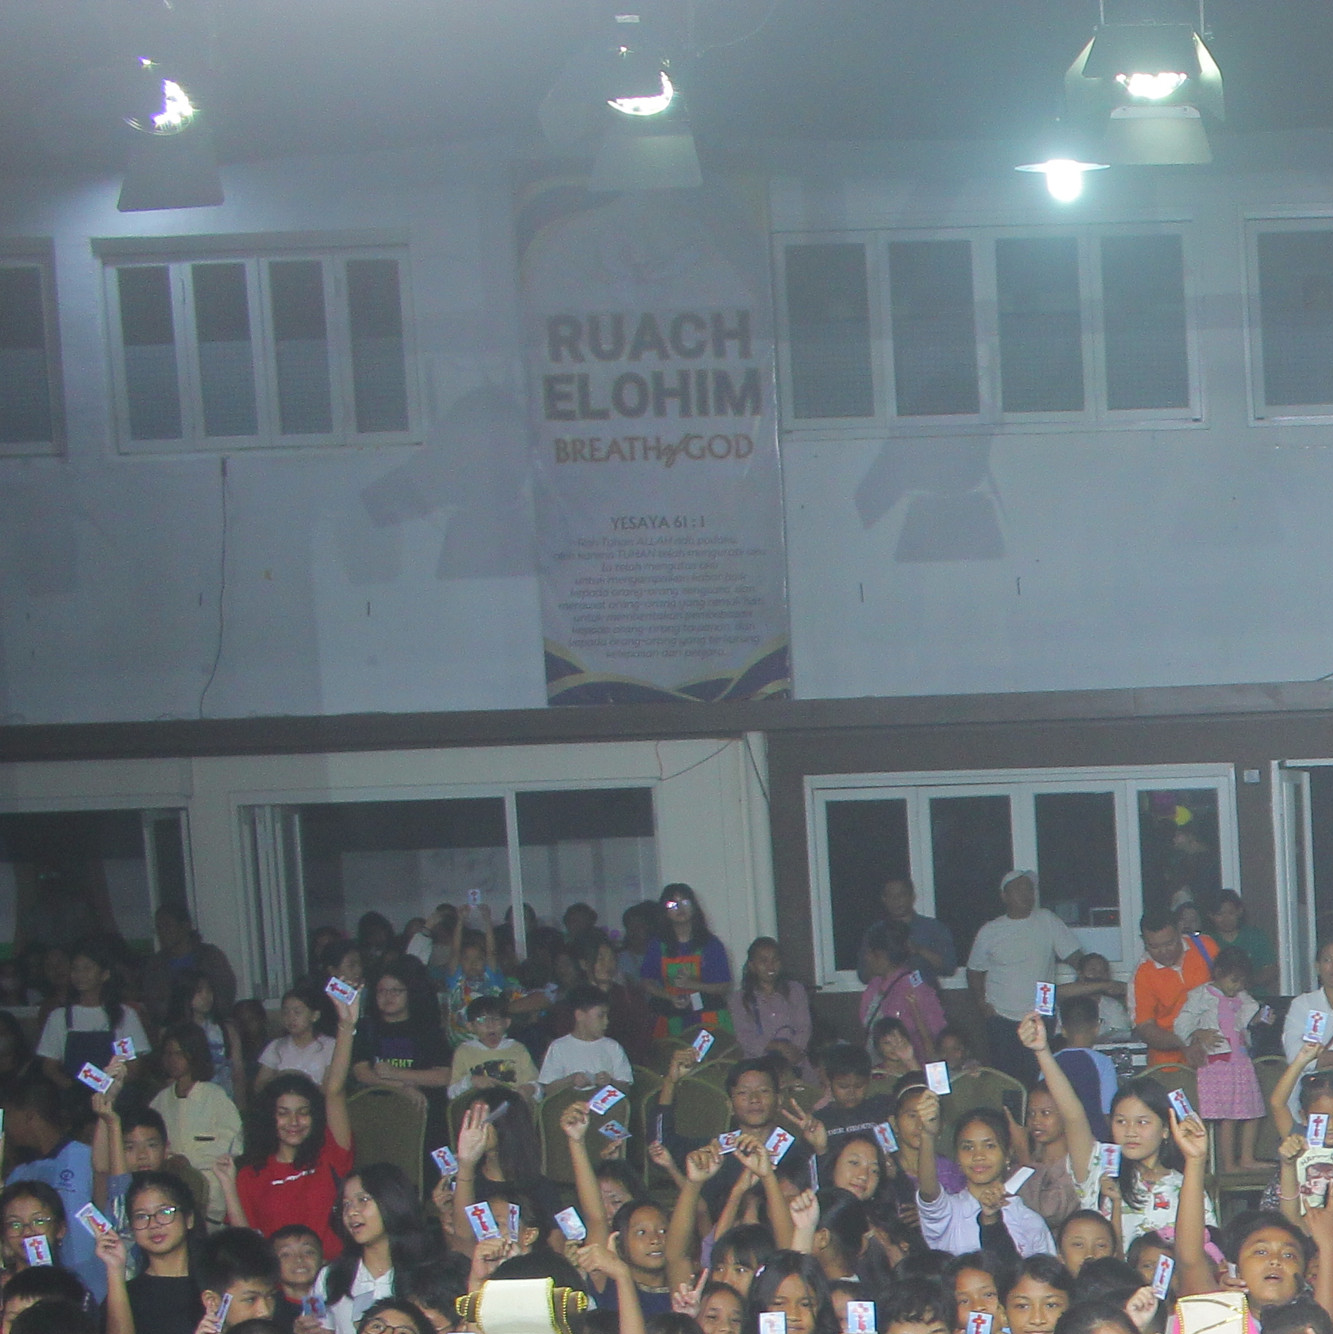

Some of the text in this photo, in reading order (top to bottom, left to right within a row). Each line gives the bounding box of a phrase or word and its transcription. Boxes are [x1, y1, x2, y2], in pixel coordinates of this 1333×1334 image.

[545, 307, 753, 364] RUACH
[543, 366, 763, 421] ELOHIM
[554, 437, 661, 464] BREATH
[685, 434, 755, 460] GOD
[611, 516, 670, 530] YESAYA
